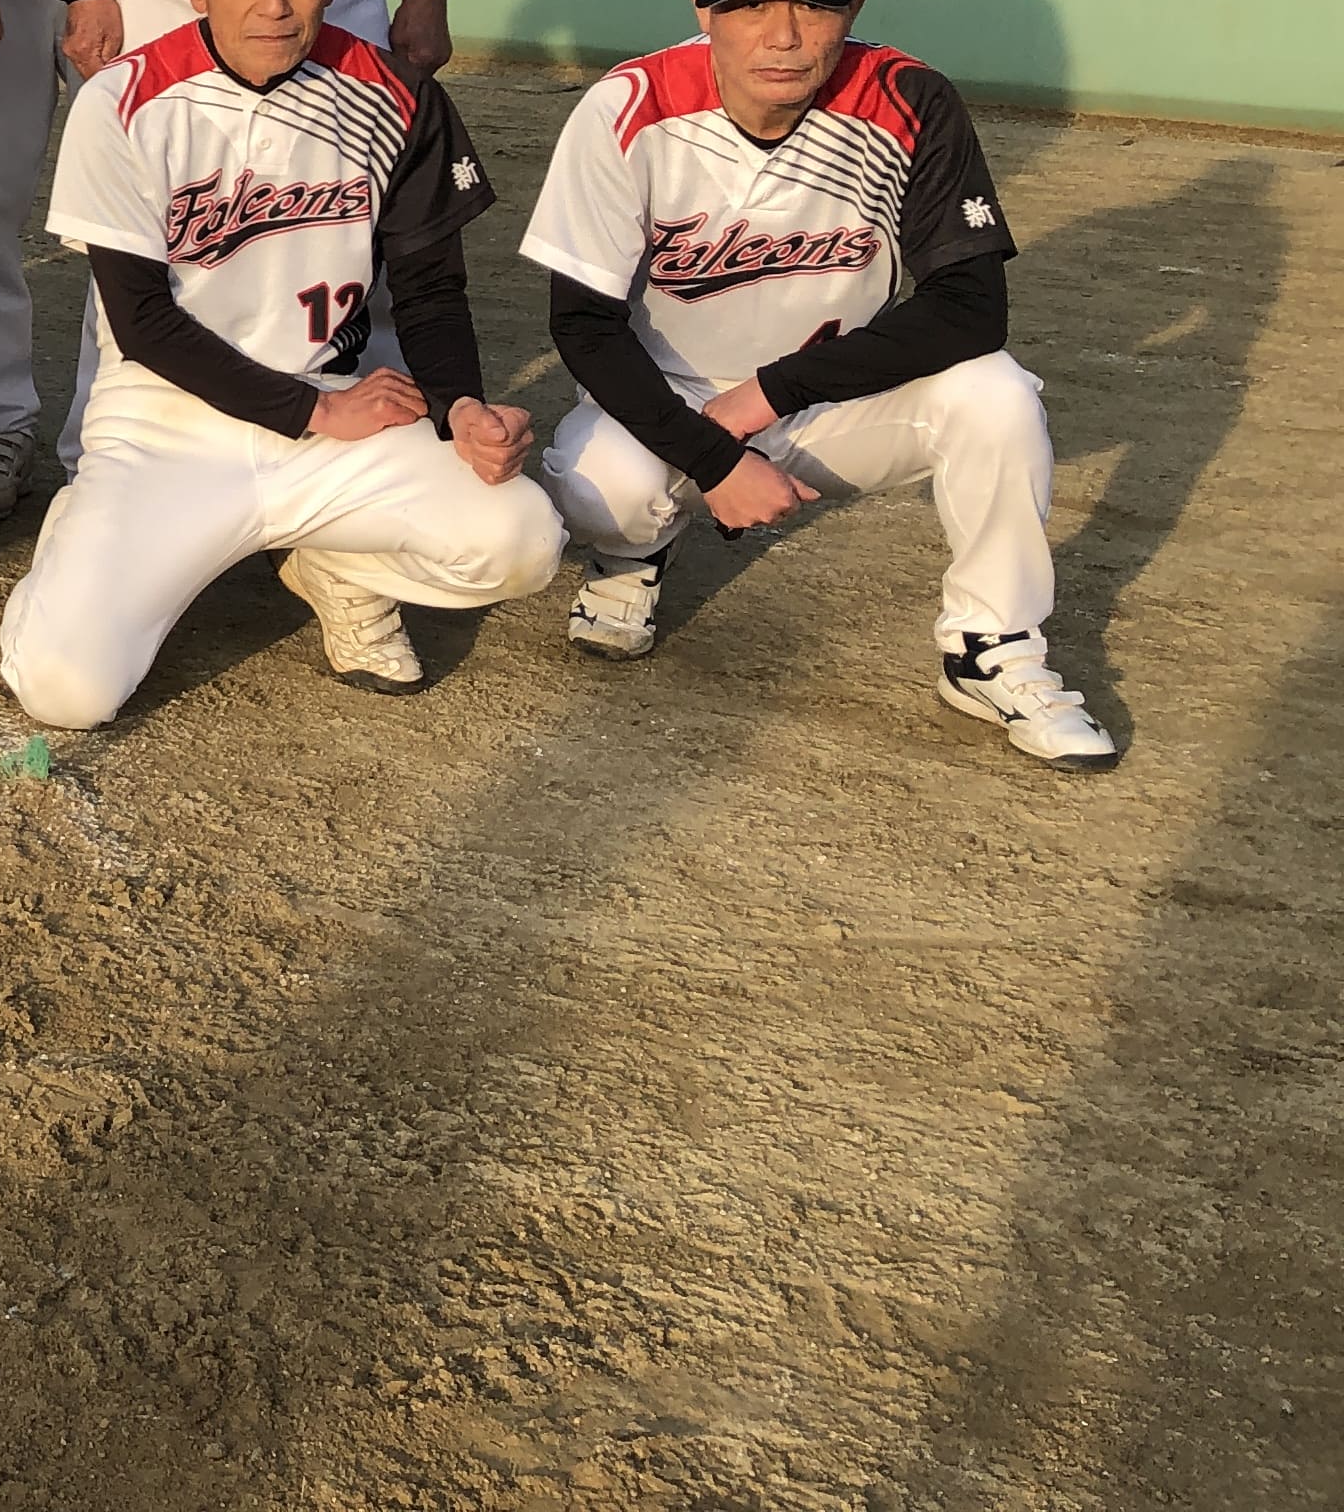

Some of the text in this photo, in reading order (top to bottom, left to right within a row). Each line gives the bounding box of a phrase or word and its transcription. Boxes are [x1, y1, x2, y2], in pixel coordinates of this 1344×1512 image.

[452, 157, 479, 191] 新
[167, 169, 371, 269] Falcons
[961, 196, 996, 228] 新
[650, 212, 881, 304] Falcons
[296, 280, 364, 343] 12
